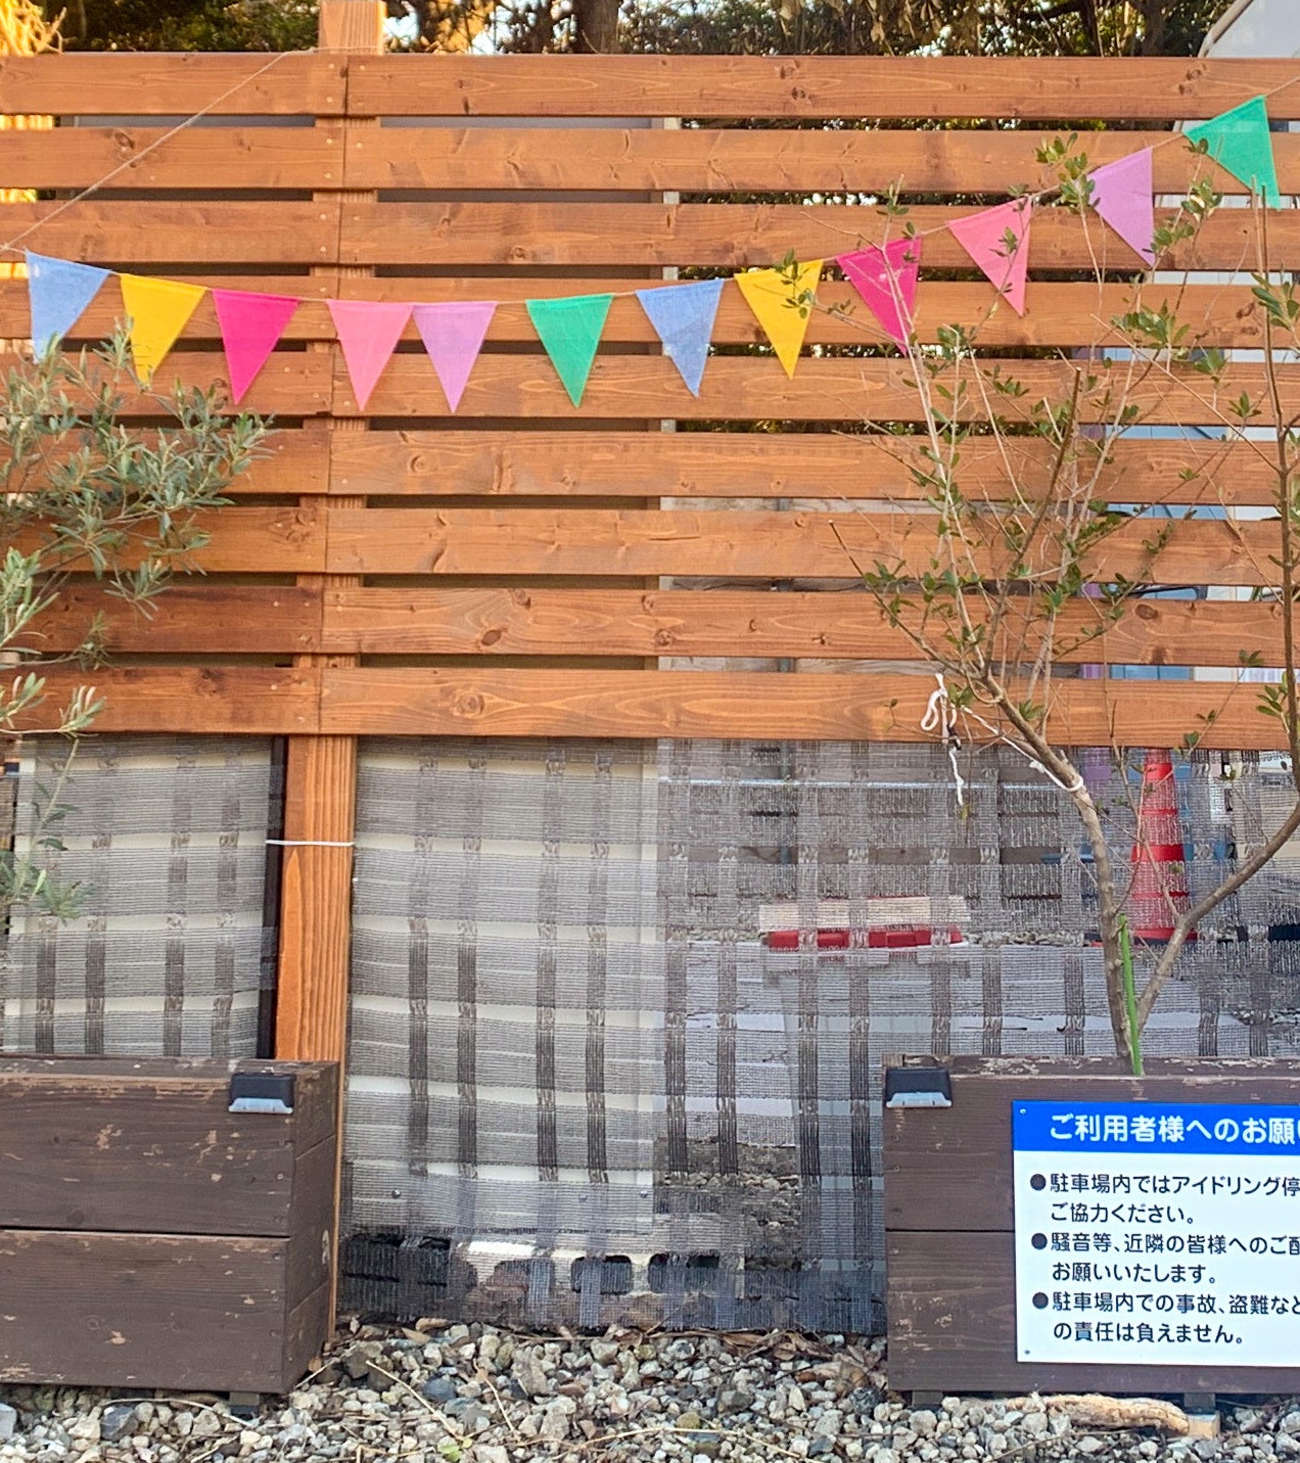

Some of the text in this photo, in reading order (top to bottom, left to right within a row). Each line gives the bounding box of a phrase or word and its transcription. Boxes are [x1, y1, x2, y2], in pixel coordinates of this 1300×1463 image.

[1051, 1202, 1194, 1225] ご協力ください。
[1052, 1262, 1216, 1284] お願いいたします。
[1053, 1321, 1243, 1344] の責任は負えません。
